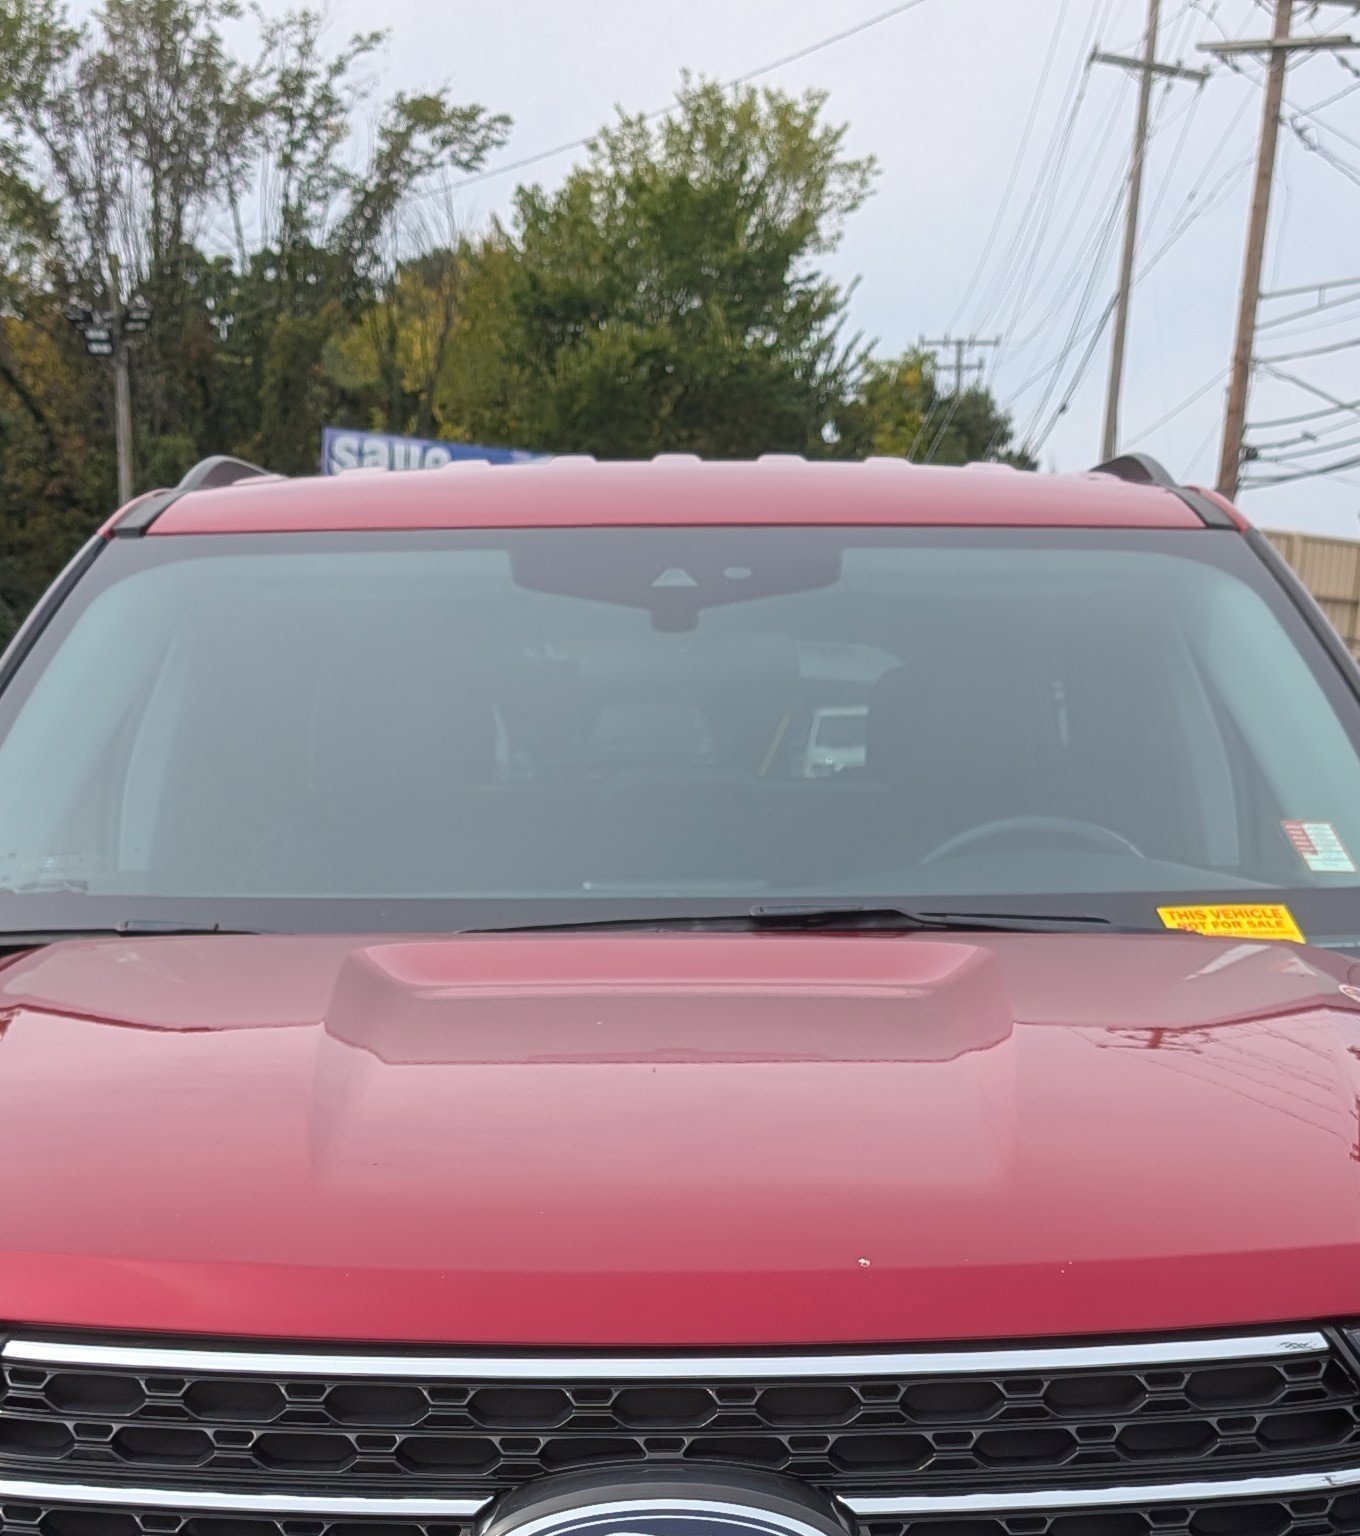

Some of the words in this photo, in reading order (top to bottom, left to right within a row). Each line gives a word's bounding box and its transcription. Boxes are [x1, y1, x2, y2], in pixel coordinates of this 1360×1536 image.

[1166, 910, 1206, 921] THIS
[1209, 908, 1284, 920] VEHICLE
[1212, 921, 1243, 930] FOR
[1247, 920, 1285, 929] SALE
